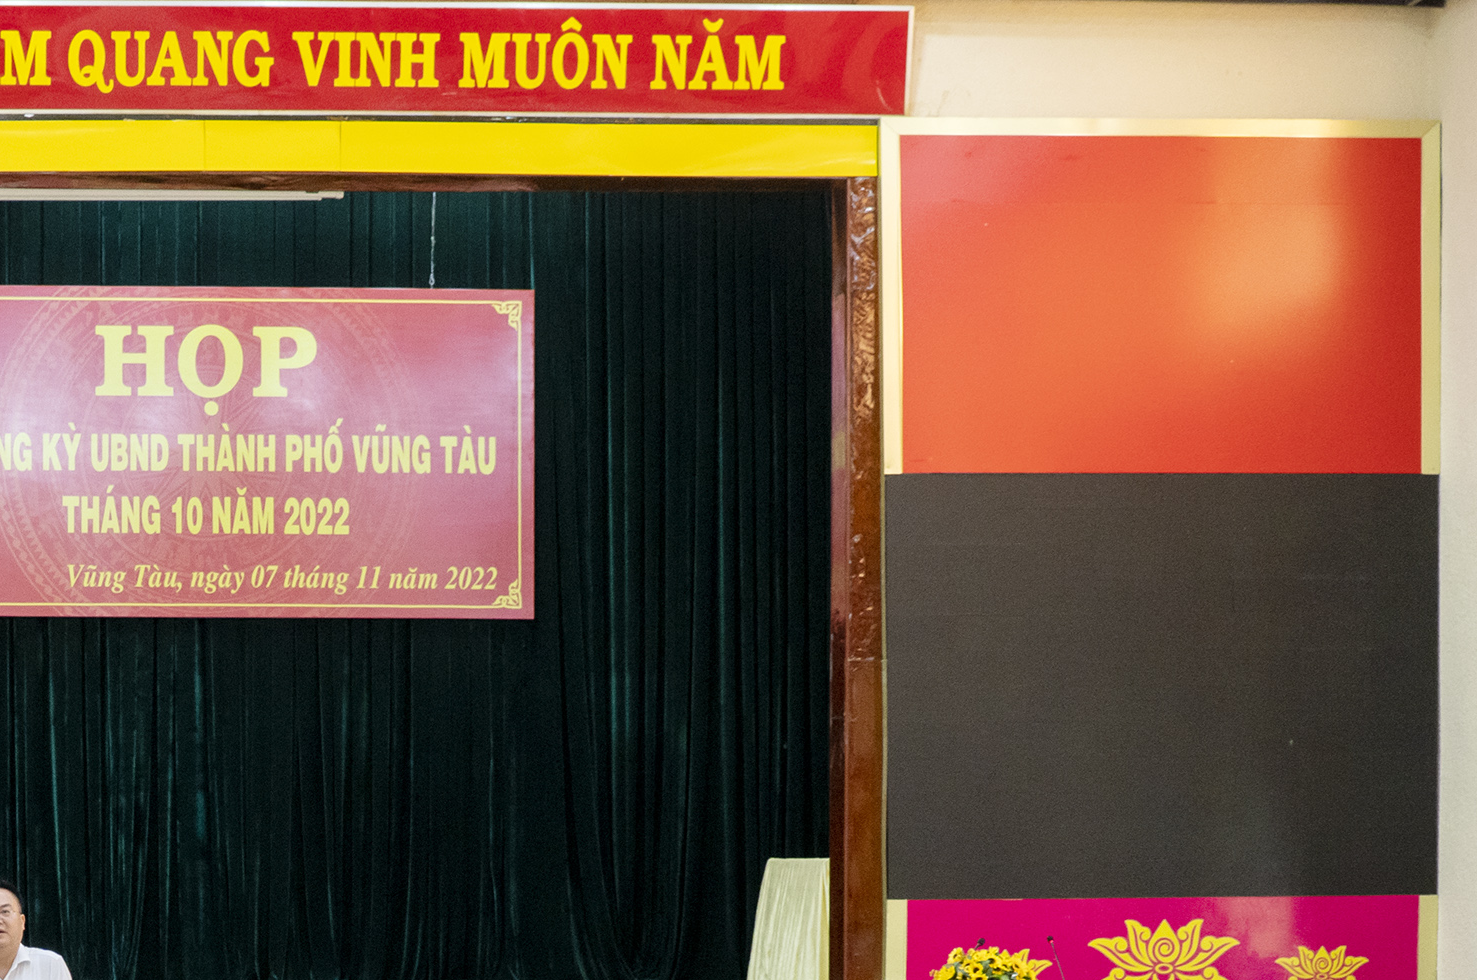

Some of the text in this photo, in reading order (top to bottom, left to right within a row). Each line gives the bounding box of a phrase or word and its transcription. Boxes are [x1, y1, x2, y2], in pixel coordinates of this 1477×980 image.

[68, 30, 274, 93] QUANG
[292, 32, 440, 87] VINH
[459, 18, 633, 89] MUÔN
[650, 18, 786, 90] NĂM
[95, 324, 317, 415] HỌP
[42, 423, 80, 471] KỲ
[90, 434, 169, 472] UBND
[178, 423, 276, 473] THÀNH
[285, 418, 344, 474] PHỐ
[352, 424, 432, 475] VŨNG
[440, 425, 497, 475] TÀU
[62, 485, 350, 536] THÁNG 10 NĂM 2022
[66, 564, 498, 595] Vũng Tàu, ngày 07 tháng 11 năm 2022
